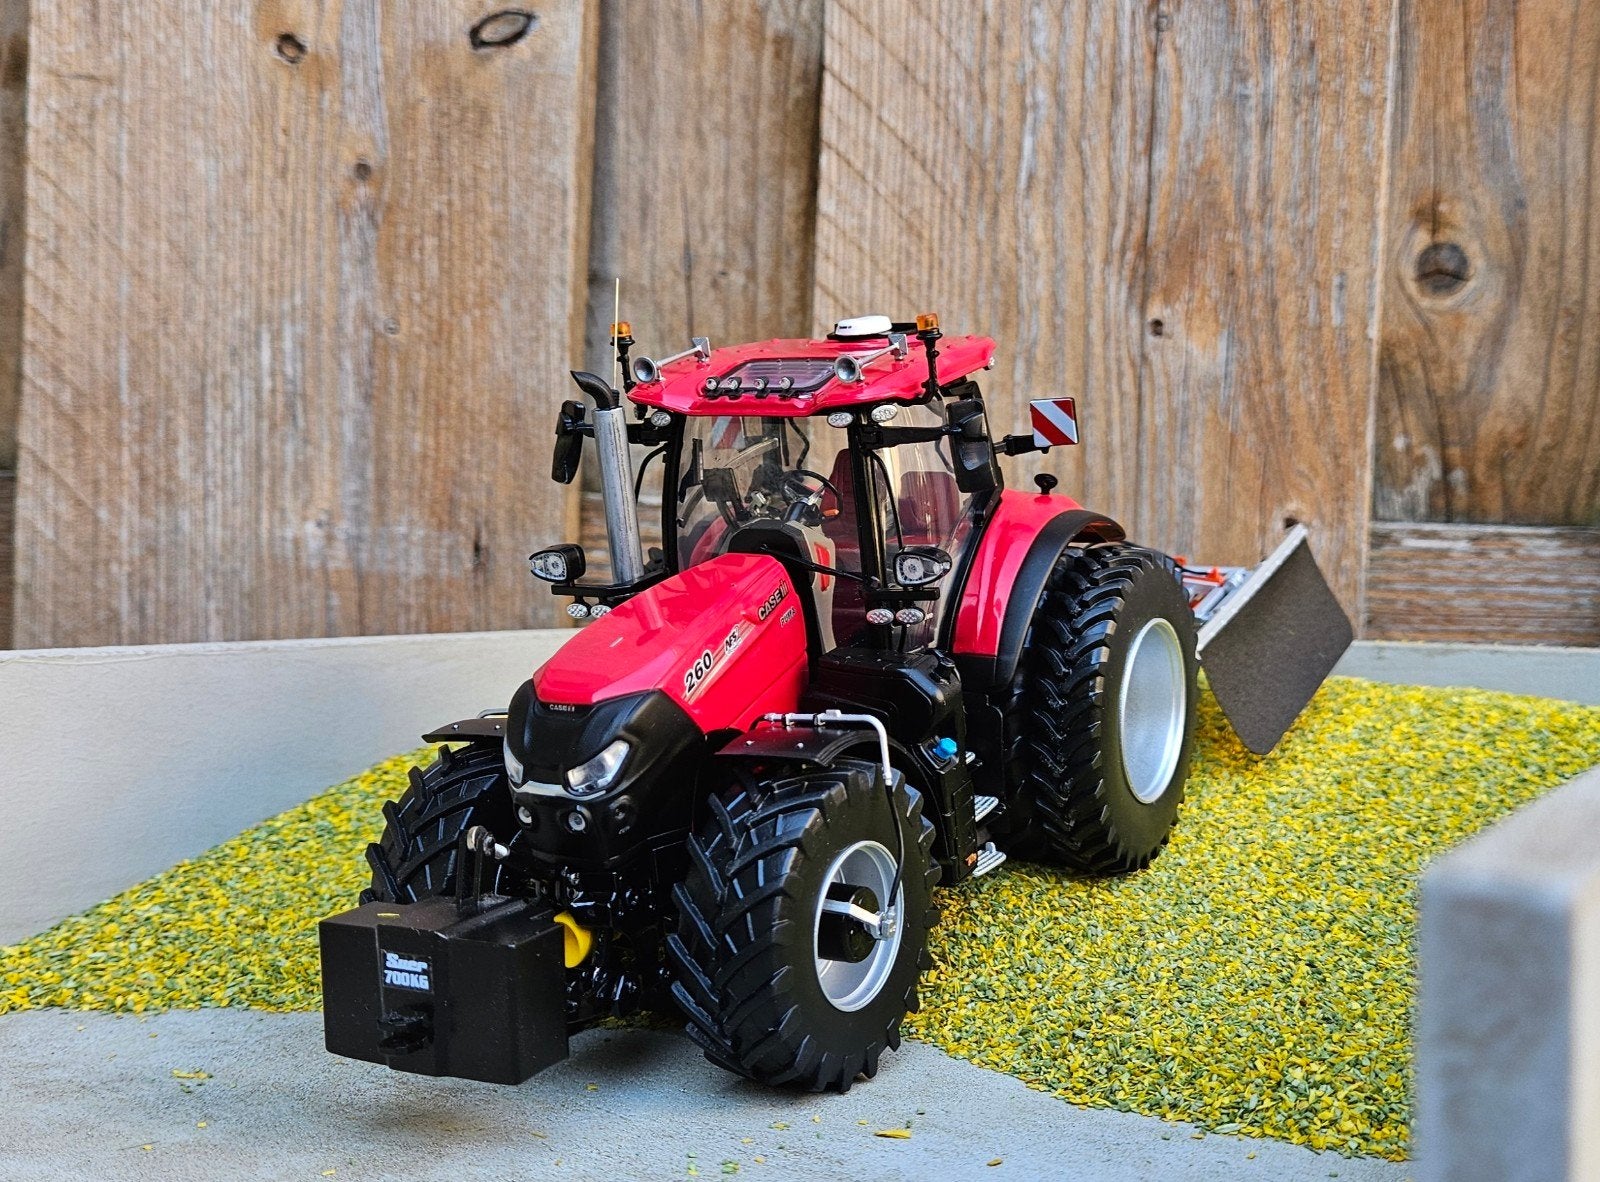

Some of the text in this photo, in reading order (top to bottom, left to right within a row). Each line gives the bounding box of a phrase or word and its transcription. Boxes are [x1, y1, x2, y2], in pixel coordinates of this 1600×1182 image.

[758, 588, 782, 621] CASE
[684, 650, 713, 694] 260
[549, 703, 567, 712] CASE
[383, 969, 430, 990] 700KG
